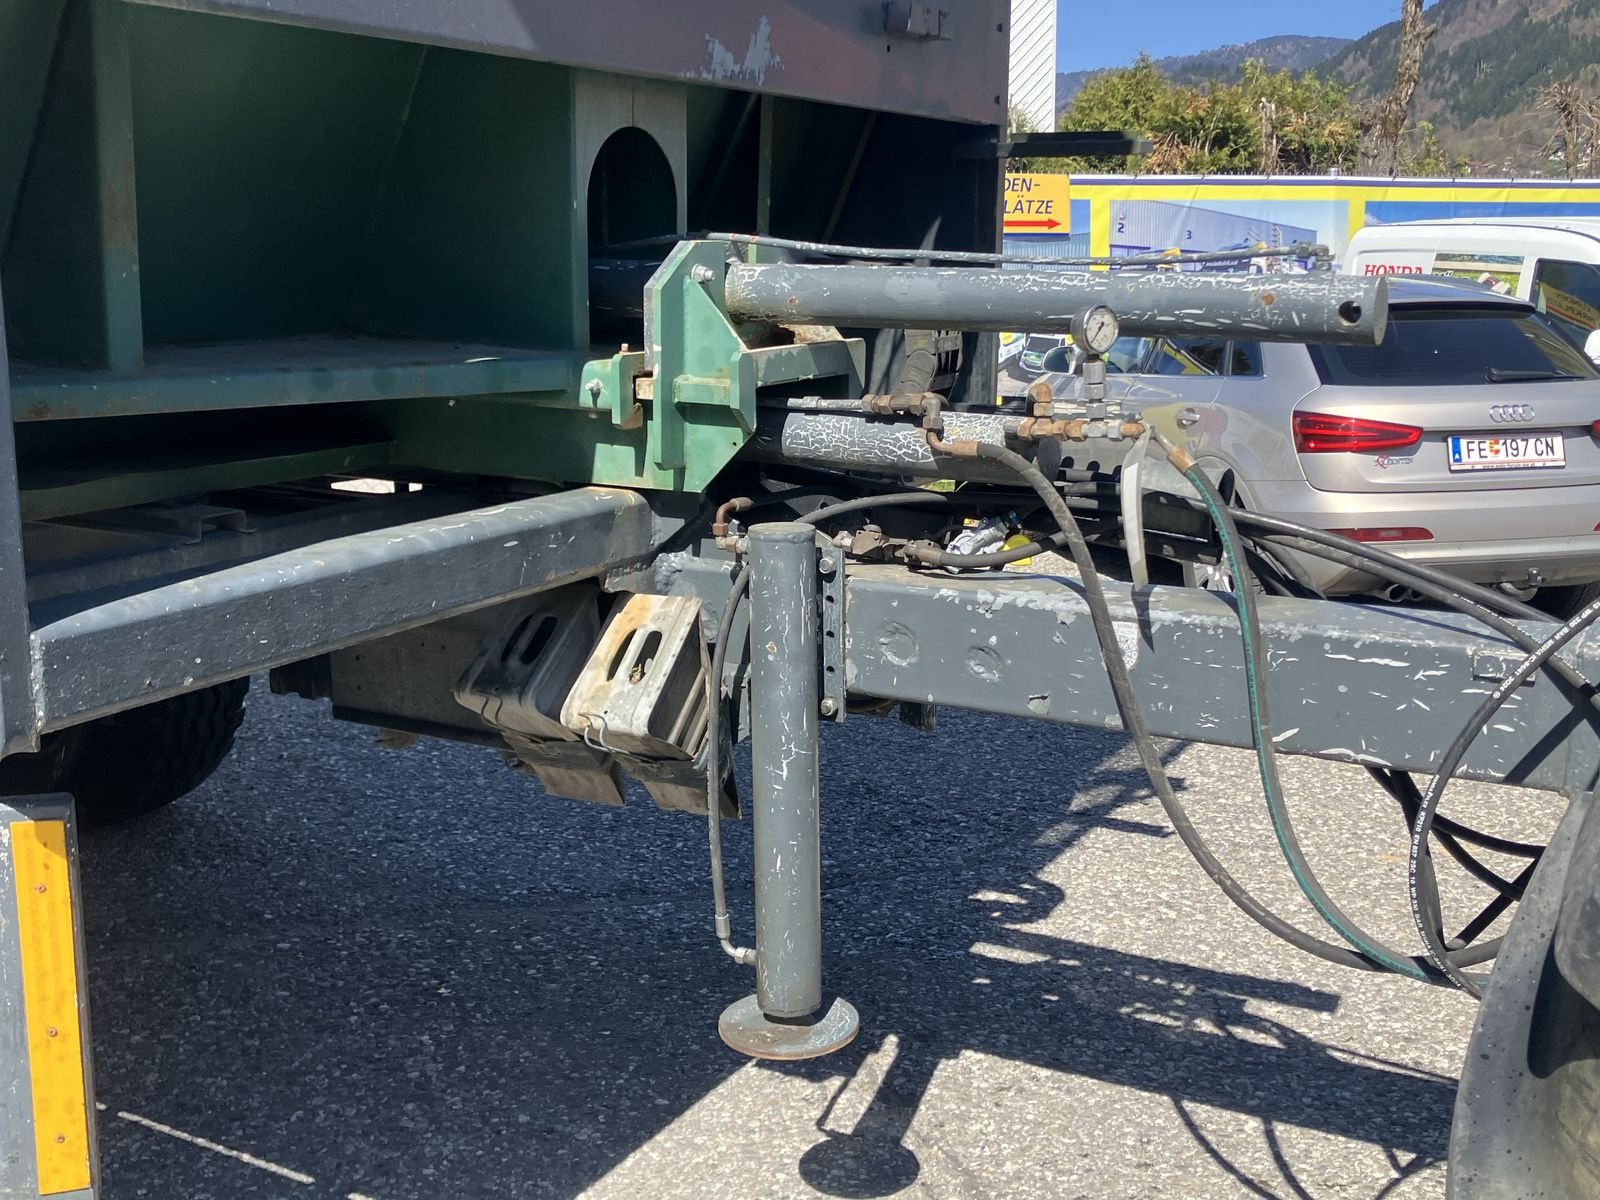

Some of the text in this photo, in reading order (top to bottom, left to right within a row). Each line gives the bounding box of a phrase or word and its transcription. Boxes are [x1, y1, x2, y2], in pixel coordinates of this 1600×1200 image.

[1003, 195, 1053, 214] LÄTZE
[1117, 222, 1125, 233] 2
[1186, 230, 1193, 240] 3
[1364, 264, 1423, 276] HONDA
[1466, 441, 1488, 459] FE
[1501, 439, 1528, 458] 197
[1534, 438, 1555, 457] CN
[1554, 627, 1570, 640] BAR
